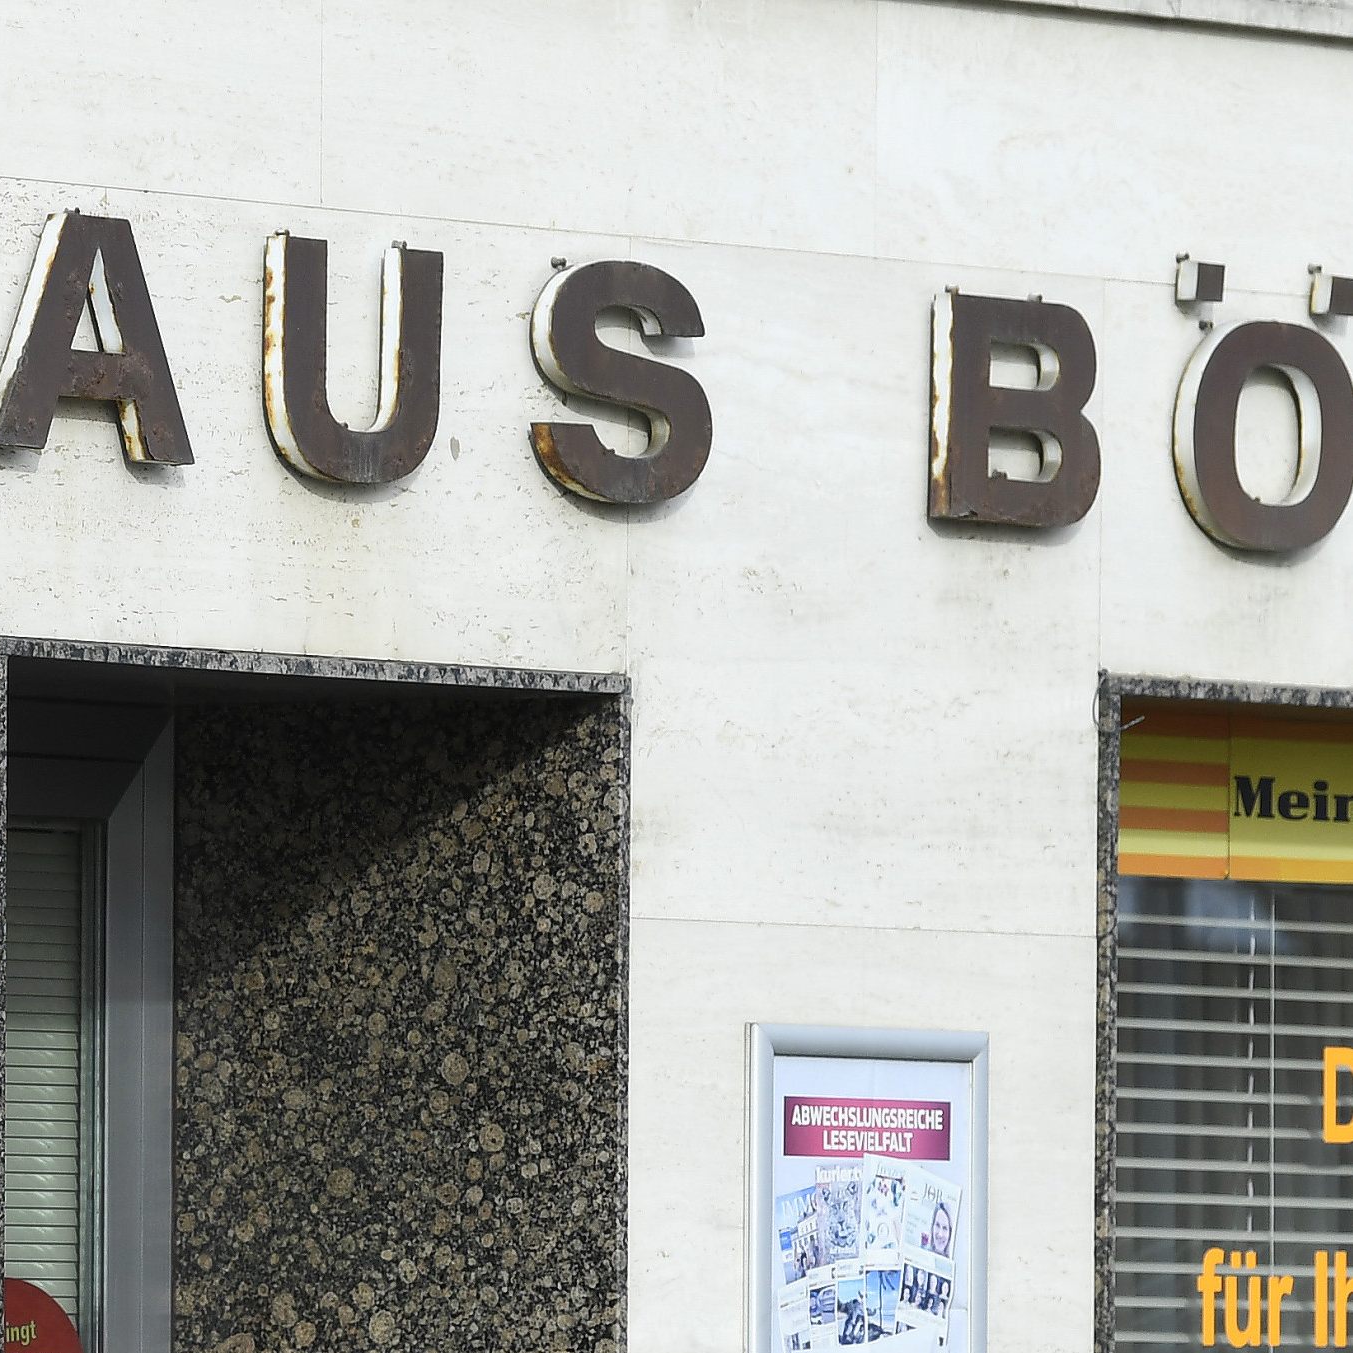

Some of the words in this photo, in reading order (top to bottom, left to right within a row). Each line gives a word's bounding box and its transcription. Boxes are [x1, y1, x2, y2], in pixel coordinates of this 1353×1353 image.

[928, 257, 1353, 552] BÖ
[792, 1105, 944, 1130] ABWECHSLUNGSREICHE
[823, 1130, 913, 1152] LESEVIELFALT
[1197, 1247, 1294, 1348] für
